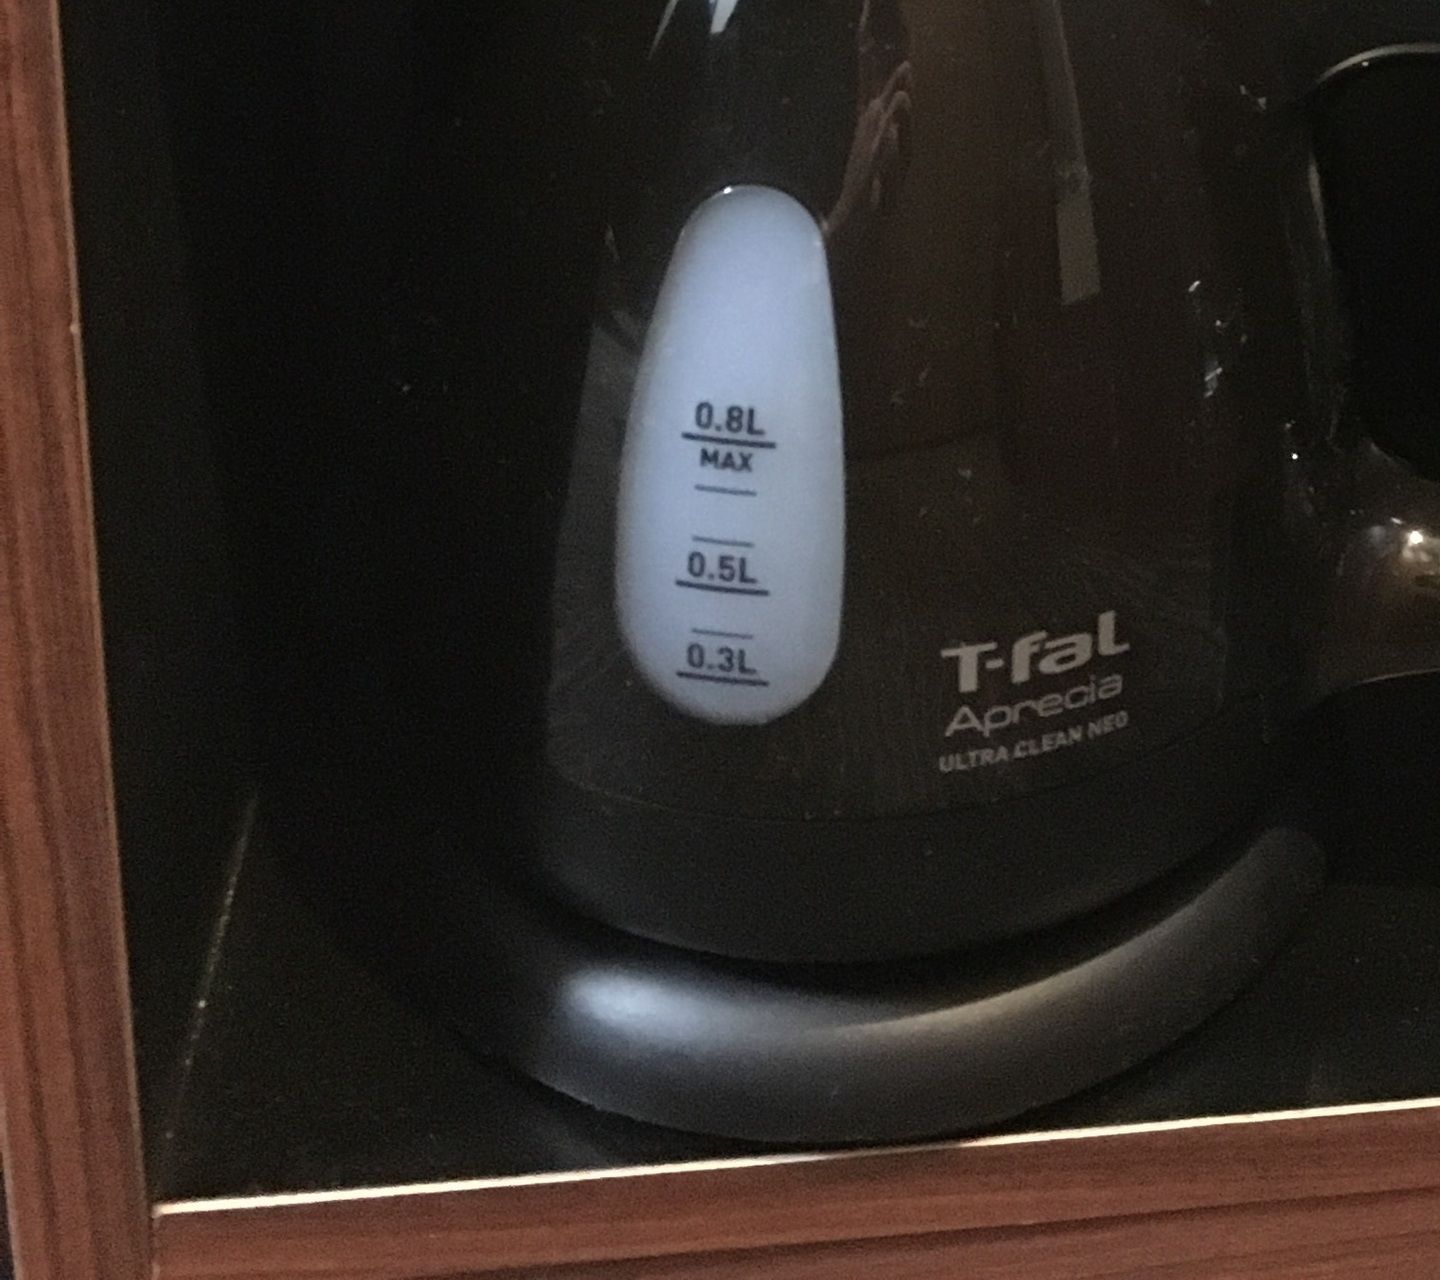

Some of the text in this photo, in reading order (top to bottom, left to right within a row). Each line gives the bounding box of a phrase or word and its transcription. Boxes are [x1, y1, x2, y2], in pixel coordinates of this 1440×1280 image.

[695, 401, 766, 437] 0.8L
[699, 448, 754, 474] MAX
[687, 552, 757, 585] 0.5L
[687, 644, 757, 676] 0.3L
[940, 610, 1131, 693] T-fal
[944, 674, 1123, 737] Aprecia
[938, 709, 1130, 774] ULTRA CLEAN NEO
